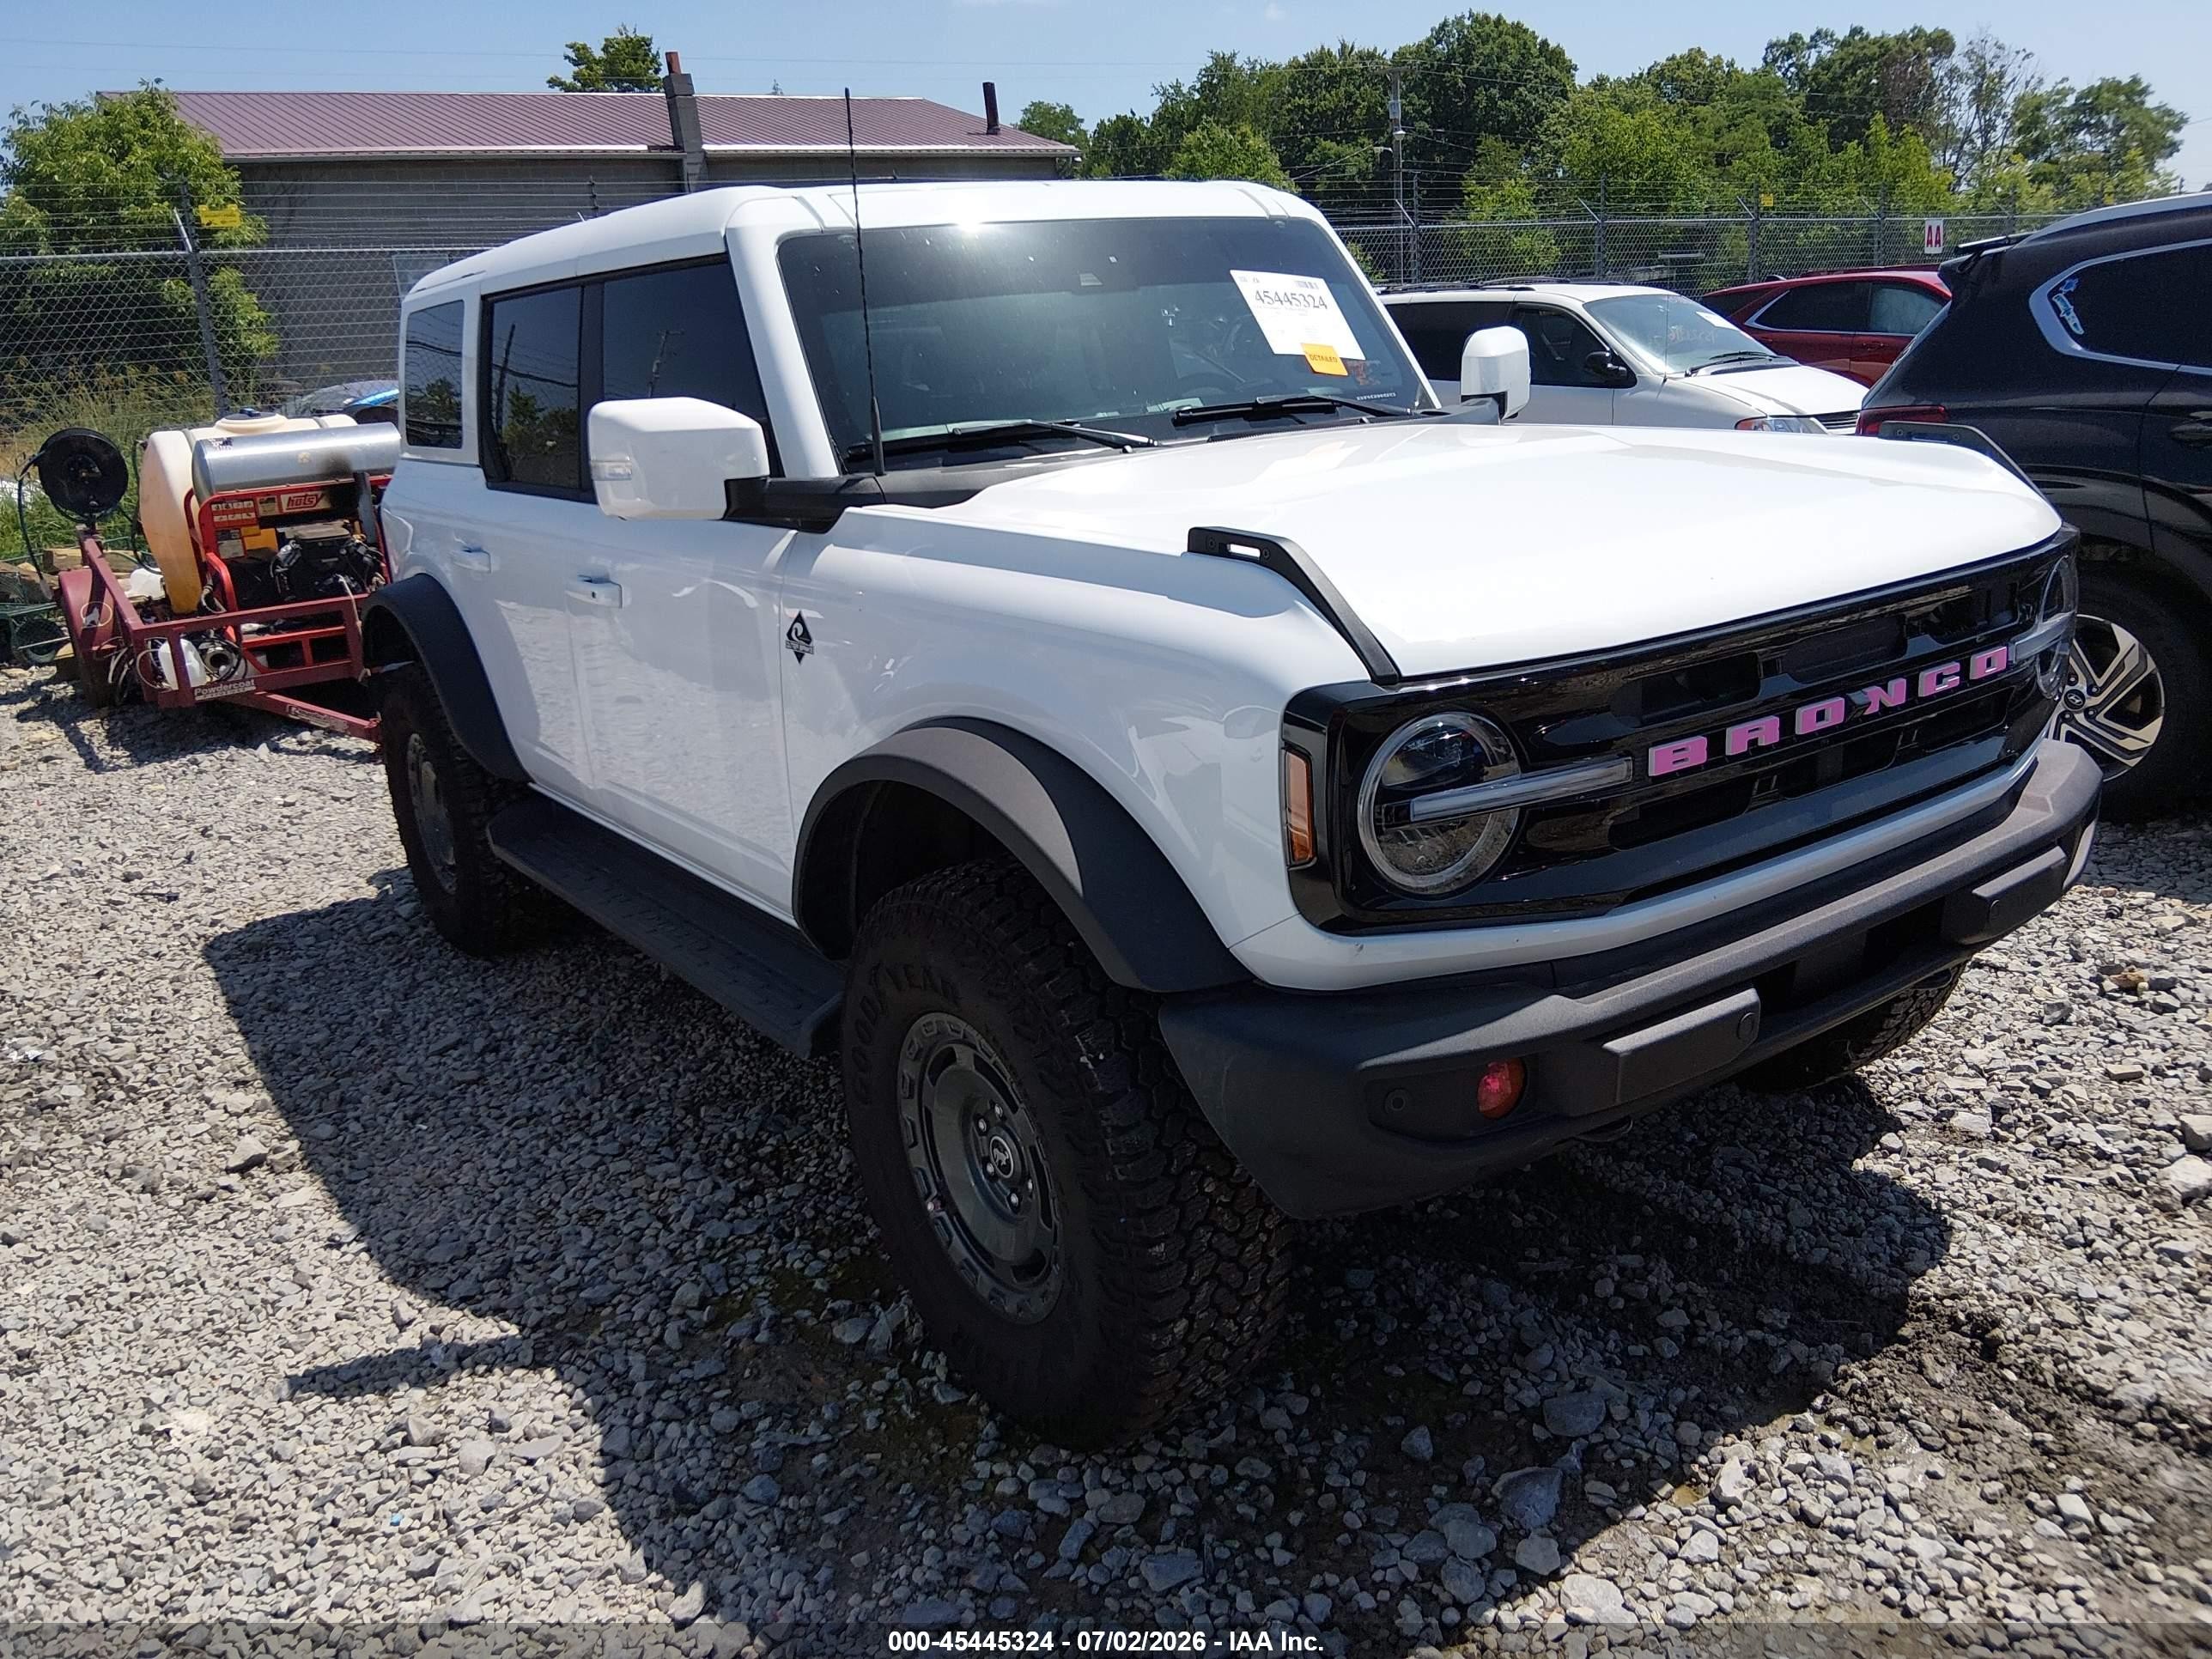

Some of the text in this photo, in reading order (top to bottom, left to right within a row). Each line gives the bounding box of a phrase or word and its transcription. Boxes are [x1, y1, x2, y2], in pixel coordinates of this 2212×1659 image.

[1926, 224, 1942, 248] AA
[1255, 289, 1328, 310] 45445324
[1309, 354, 1338, 363] DETAILED
[1648, 646, 2008, 777] BRONCO
